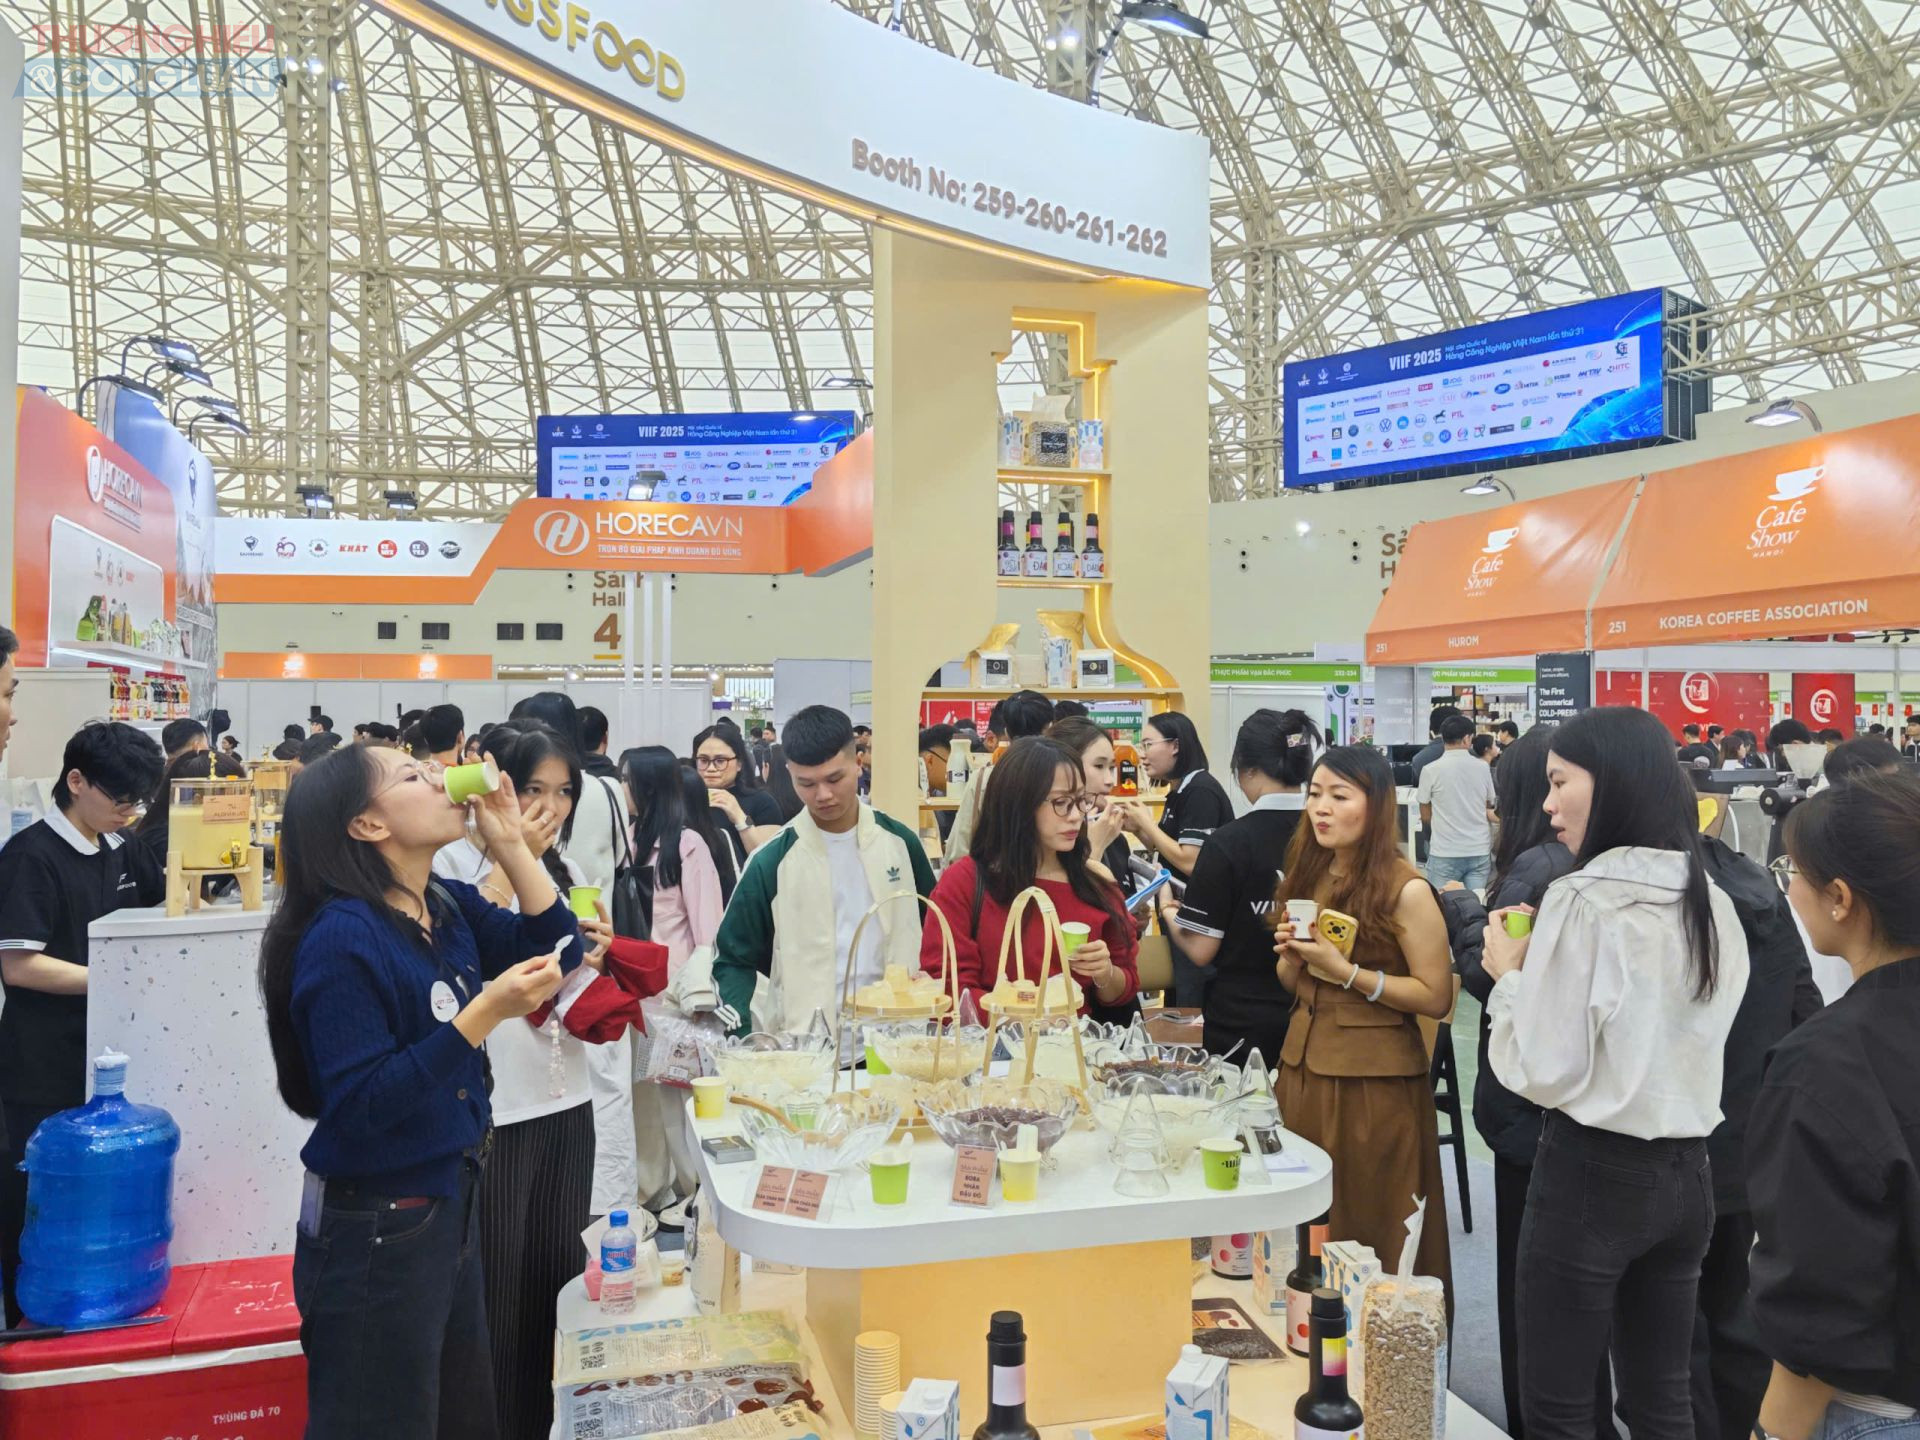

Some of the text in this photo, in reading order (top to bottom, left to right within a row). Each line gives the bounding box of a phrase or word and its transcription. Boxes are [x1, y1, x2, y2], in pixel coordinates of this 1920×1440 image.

[852, 138, 1168, 258] Booth No: 259-260-261-262
[1529, 335, 1547, 345] Nam
[1389, 348, 1442, 371] VIIF 2025
[638, 425, 685, 438] VIIF 2025
[595, 511, 744, 538] HORECAVN
[1756, 500, 1807, 530] Cafe
[1746, 528, 1800, 550] Show
[1472, 554, 1504, 575] Cafe
[1464, 574, 1499, 591] Show
[1608, 599, 1869, 634] 251 KOREA COFFEE ASSOCIATION
[593, 613, 622, 650] 4
[1375, 636, 1479, 653] 251 HUROM
[1540, 688, 1550, 696] The
[1116, 716, 1135, 724] THAY
[212, 1406, 281, 1425] THÙNG ĐÁ 70
